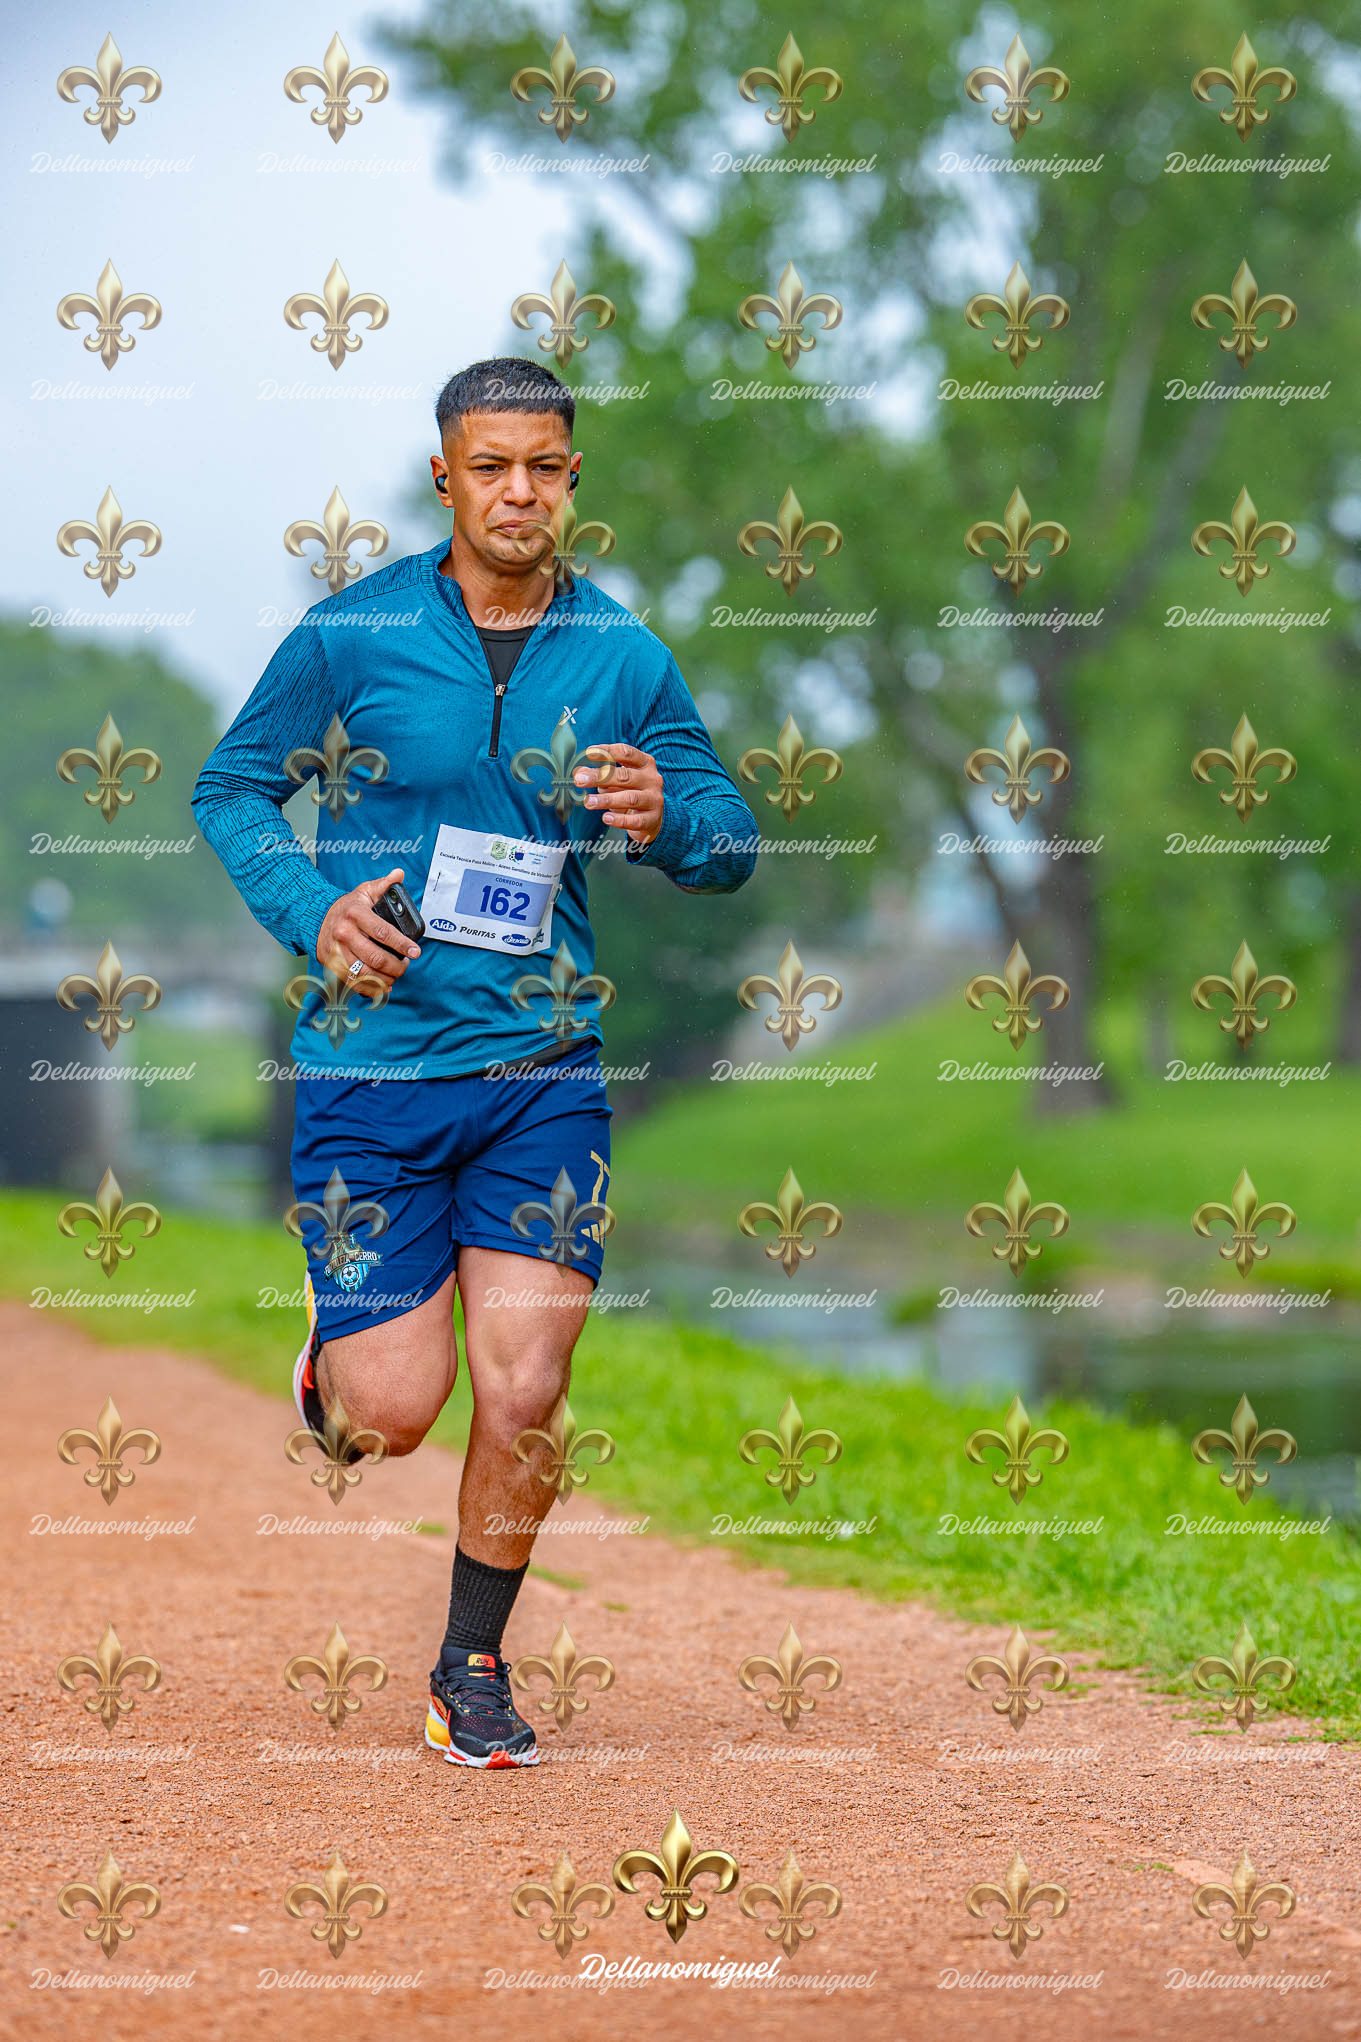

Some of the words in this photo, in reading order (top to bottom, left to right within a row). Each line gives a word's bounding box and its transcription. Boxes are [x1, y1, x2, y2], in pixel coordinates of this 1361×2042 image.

[495, 877, 523, 887] CORREDOR
[480, 885, 530, 920] 162
[459, 926, 497, 939] PURITAS
[354, 1251, 378, 1261] CERRO
